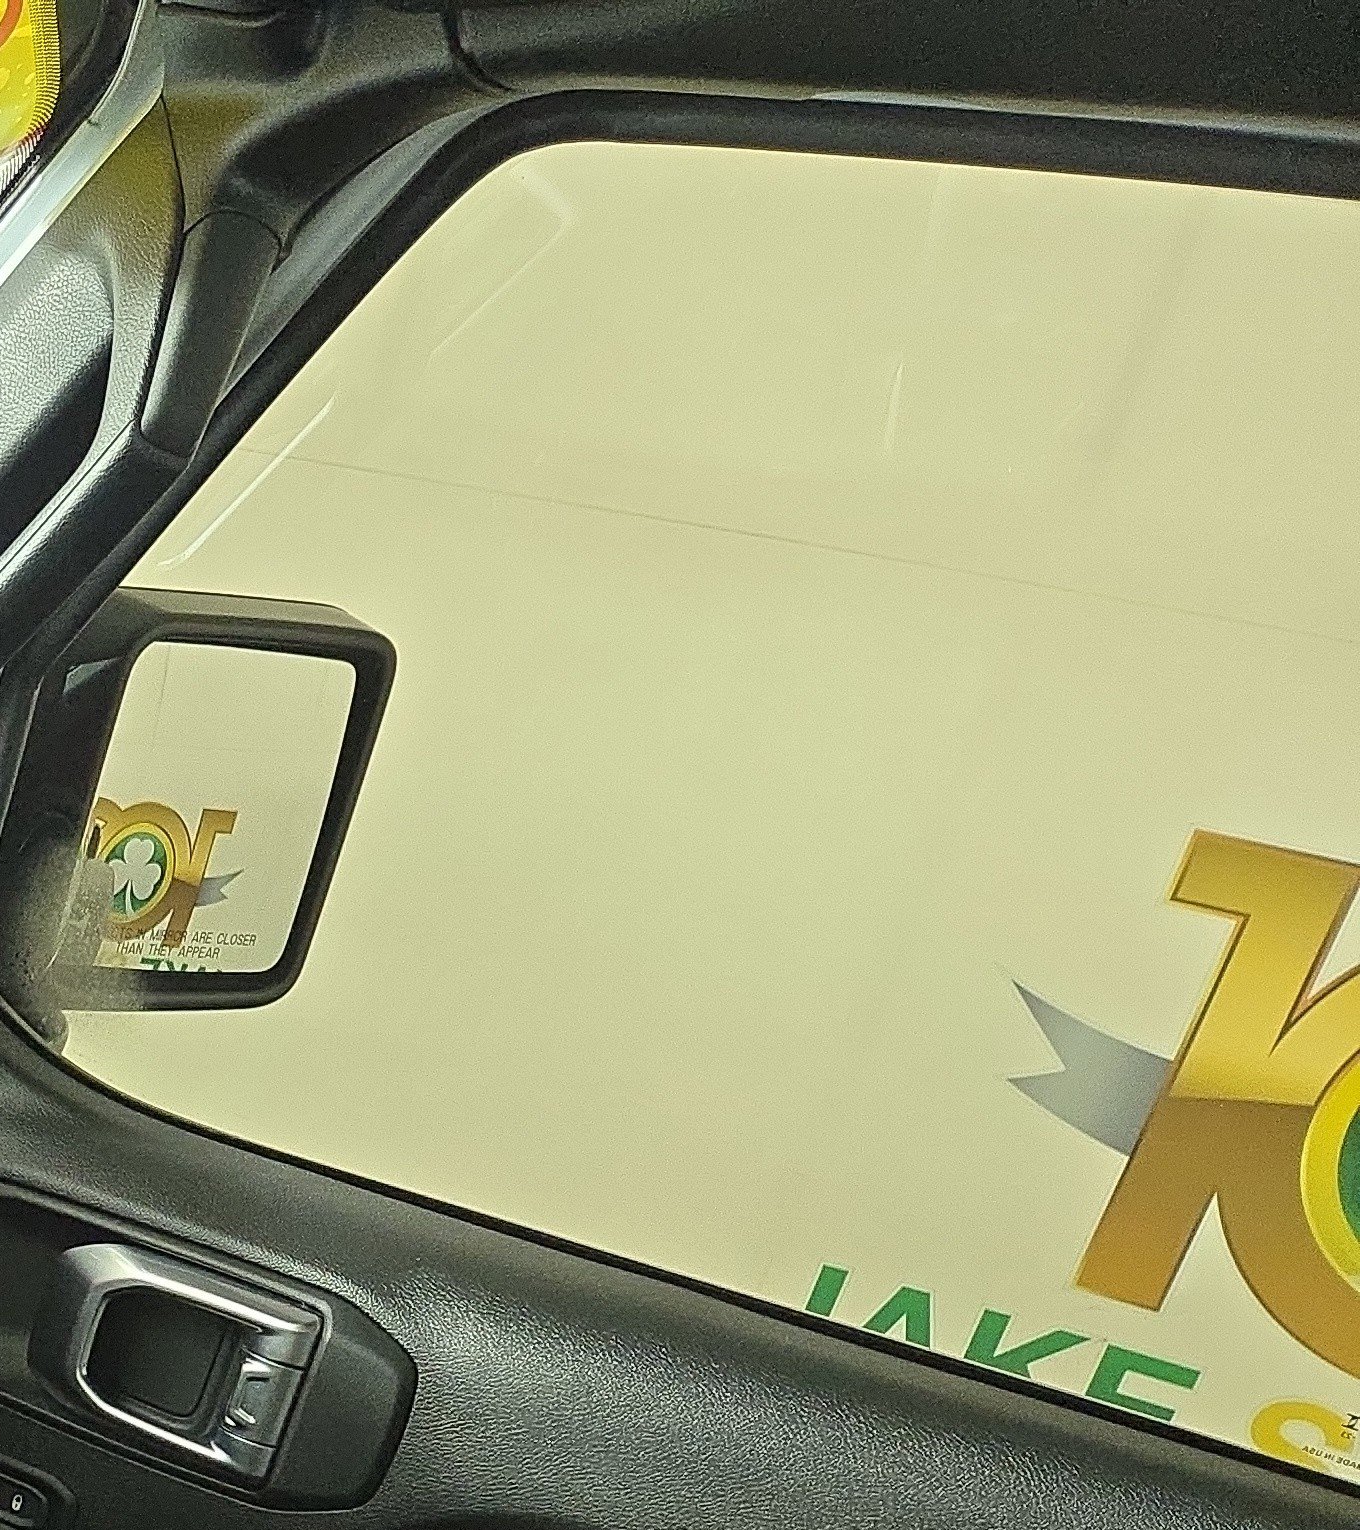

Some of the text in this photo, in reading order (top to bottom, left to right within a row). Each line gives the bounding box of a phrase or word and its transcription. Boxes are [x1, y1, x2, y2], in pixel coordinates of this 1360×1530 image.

[192, 931, 212, 944] ARE
[217, 933, 257, 946] CLOSER
[116, 941, 221, 959] THAN THEY APPEAR
